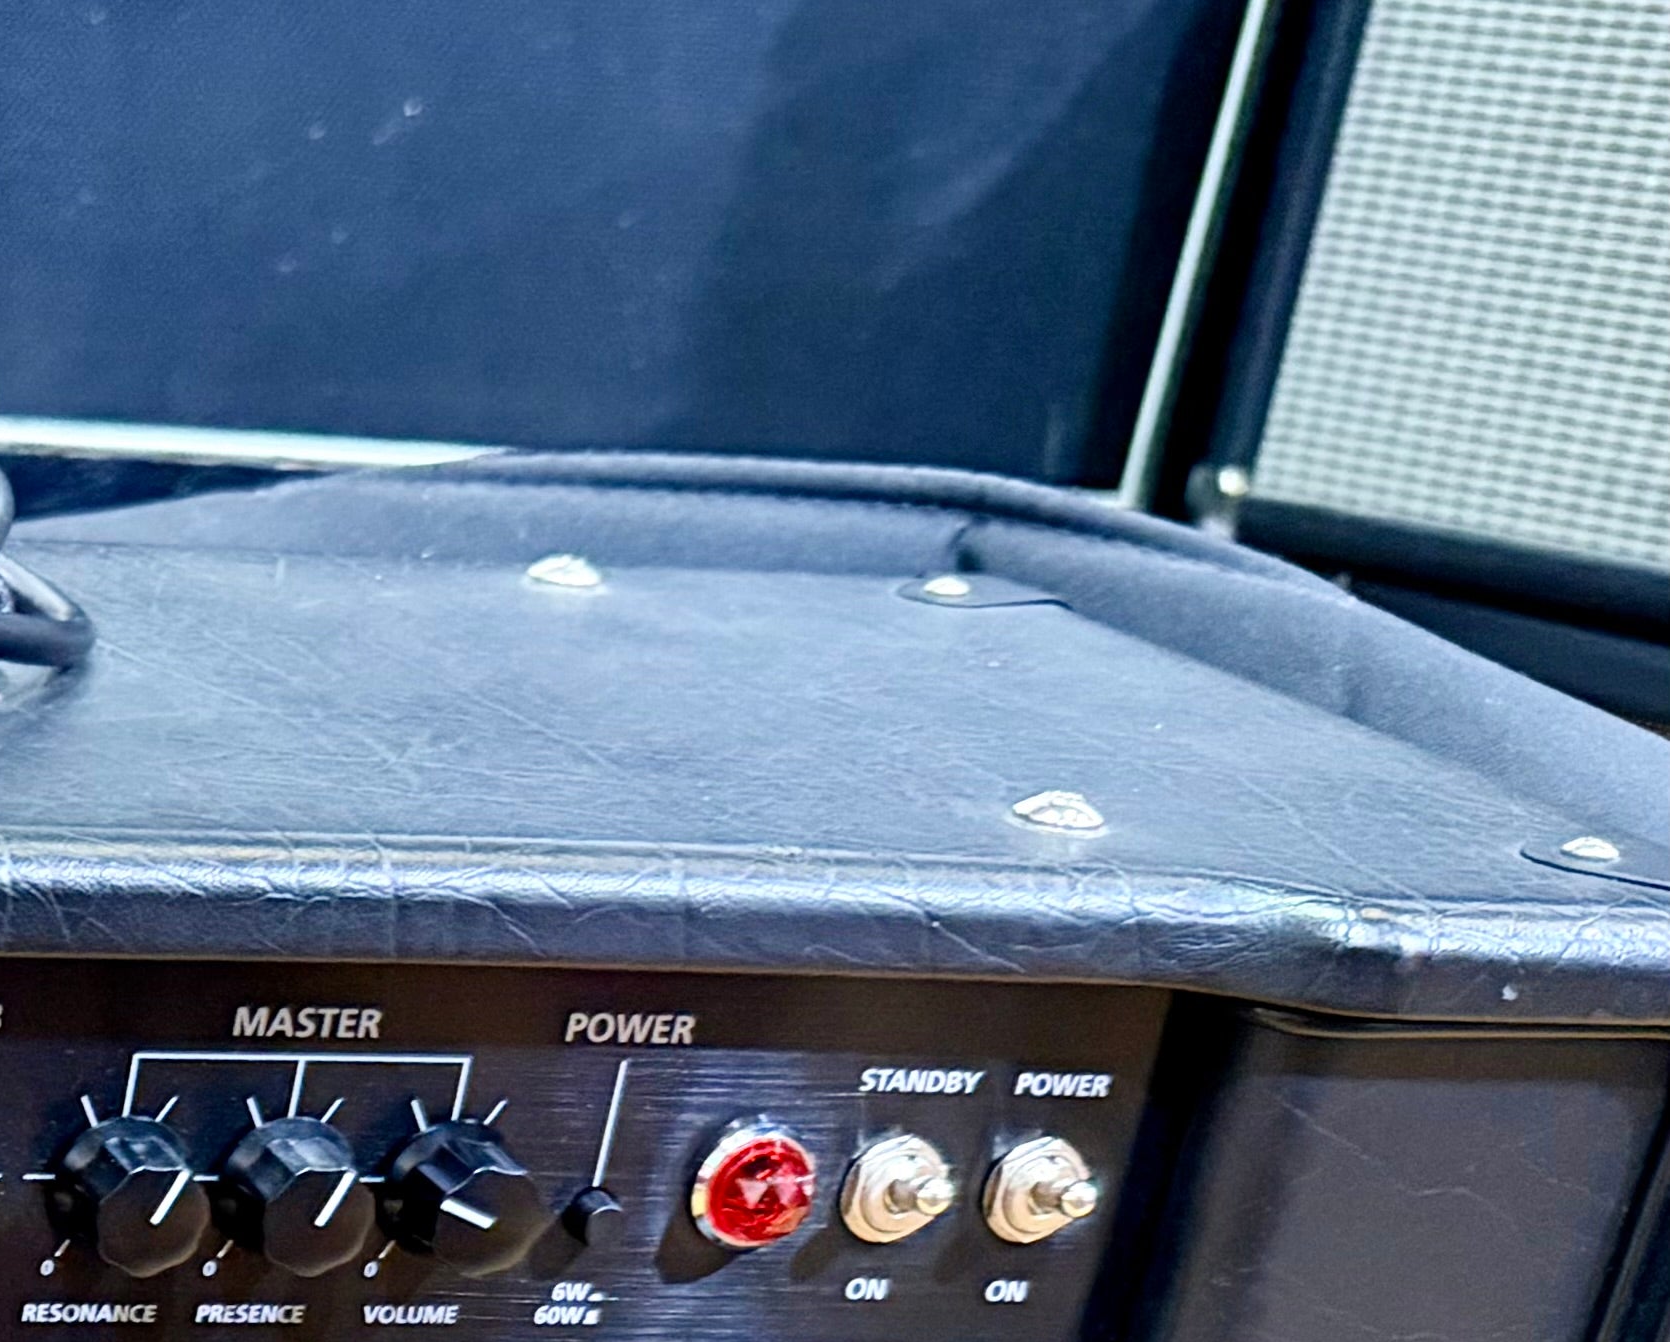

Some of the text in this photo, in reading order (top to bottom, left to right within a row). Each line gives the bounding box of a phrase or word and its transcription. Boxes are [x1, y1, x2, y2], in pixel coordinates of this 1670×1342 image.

[232, 1006, 383, 1039] MASTER
[565, 1012, 696, 1045] POWER
[859, 1067, 985, 1096] STANDBY
[1014, 1072, 1111, 1098] POWER
[40, 1259, 55, 1276] 0
[202, 1260, 217, 1277] 0
[363, 1261, 379, 1278] 0
[551, 1281, 593, 1302] 6W
[845, 1277, 889, 1301] ON
[984, 1279, 1029, 1303] ON
[21, 1303, 158, 1323] RESONANCE
[194, 1303, 306, 1324] PRESENCE
[363, 1304, 460, 1325] VOLUME
[533, 1304, 587, 1325] 60W
